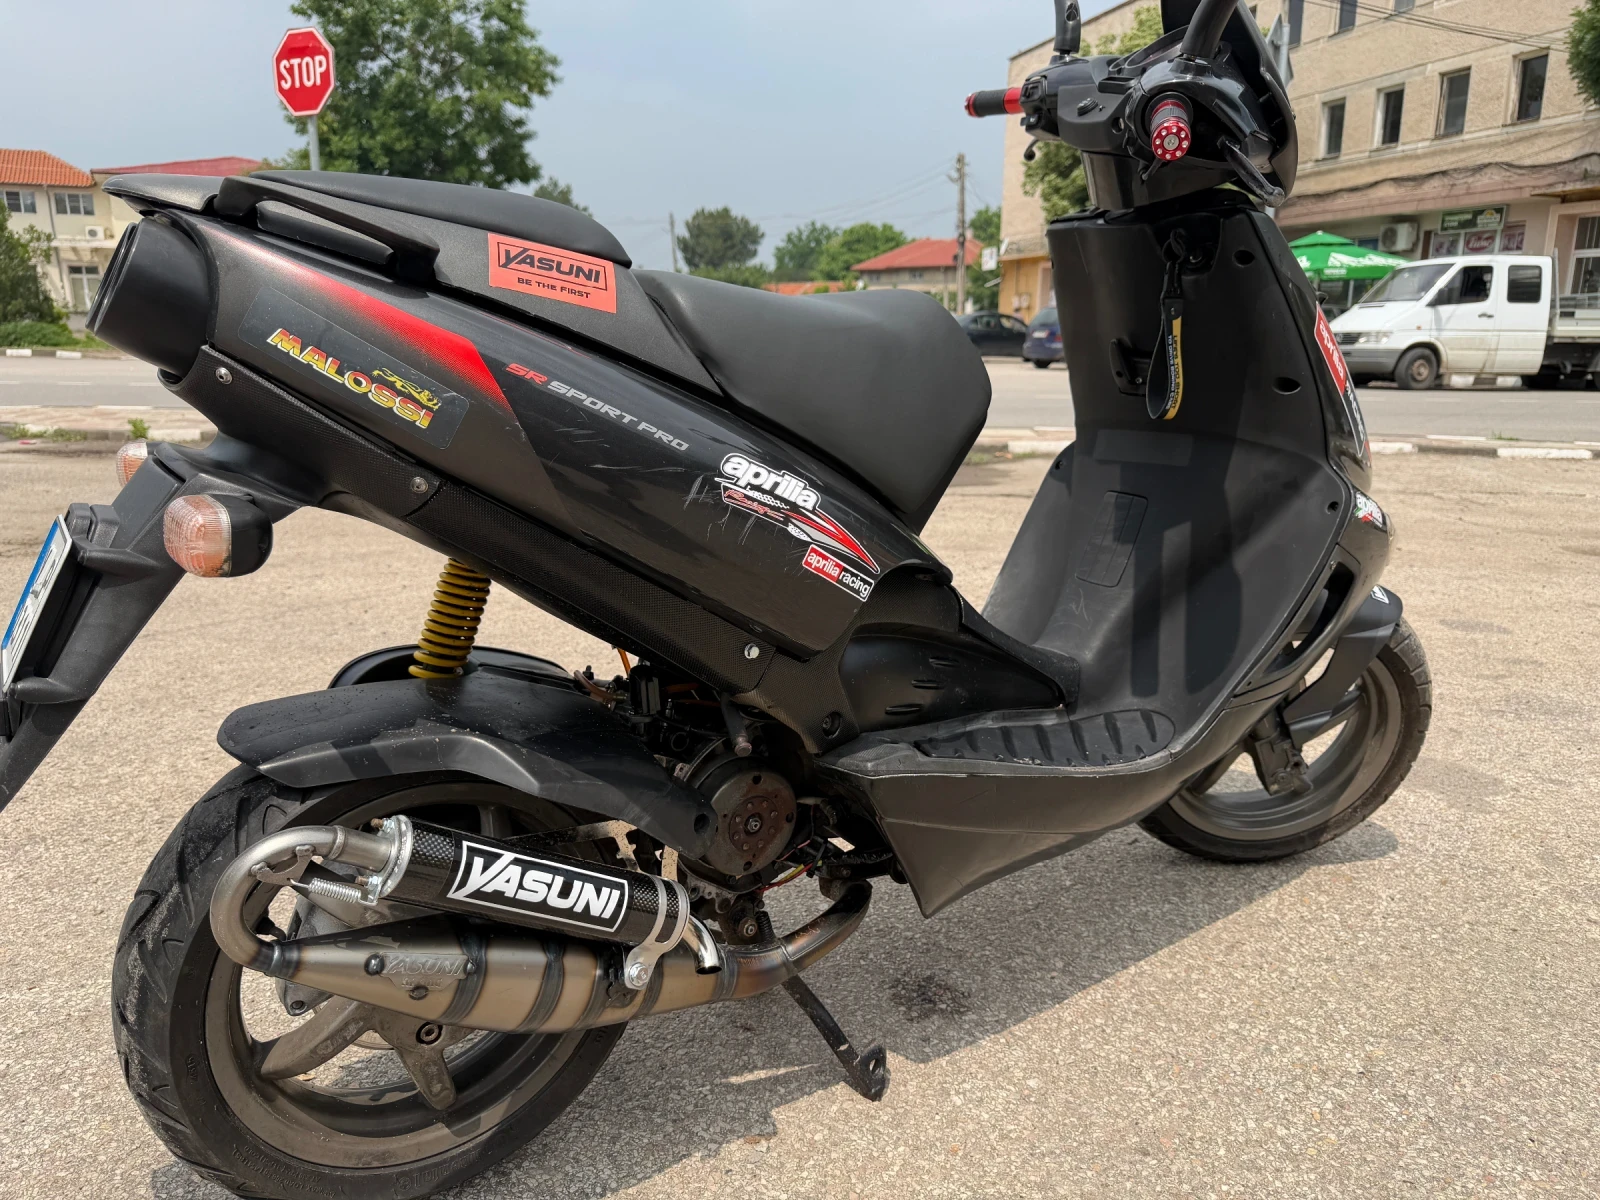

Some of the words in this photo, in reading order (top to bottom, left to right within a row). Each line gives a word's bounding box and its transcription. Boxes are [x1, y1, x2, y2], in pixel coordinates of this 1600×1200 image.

[279, 54, 327, 90] STOP
[500, 247, 601, 283] YASUNI
[517, 277, 532, 287] BE
[535, 281, 557, 291] THE
[560, 286, 591, 299] FIRST
[1319, 319, 1344, 381] aprilia
[266, 328, 434, 429] MALOSSI
[505, 363, 548, 386] SR
[547, 380, 638, 424] SPORT
[637, 421, 690, 451] PRO
[722, 456, 818, 511] aprilia
[807, 552, 840, 578] aprilia
[838, 570, 871, 598] racing
[450, 852, 621, 919] YASUNI
[383, 954, 464, 976] YASUNI
